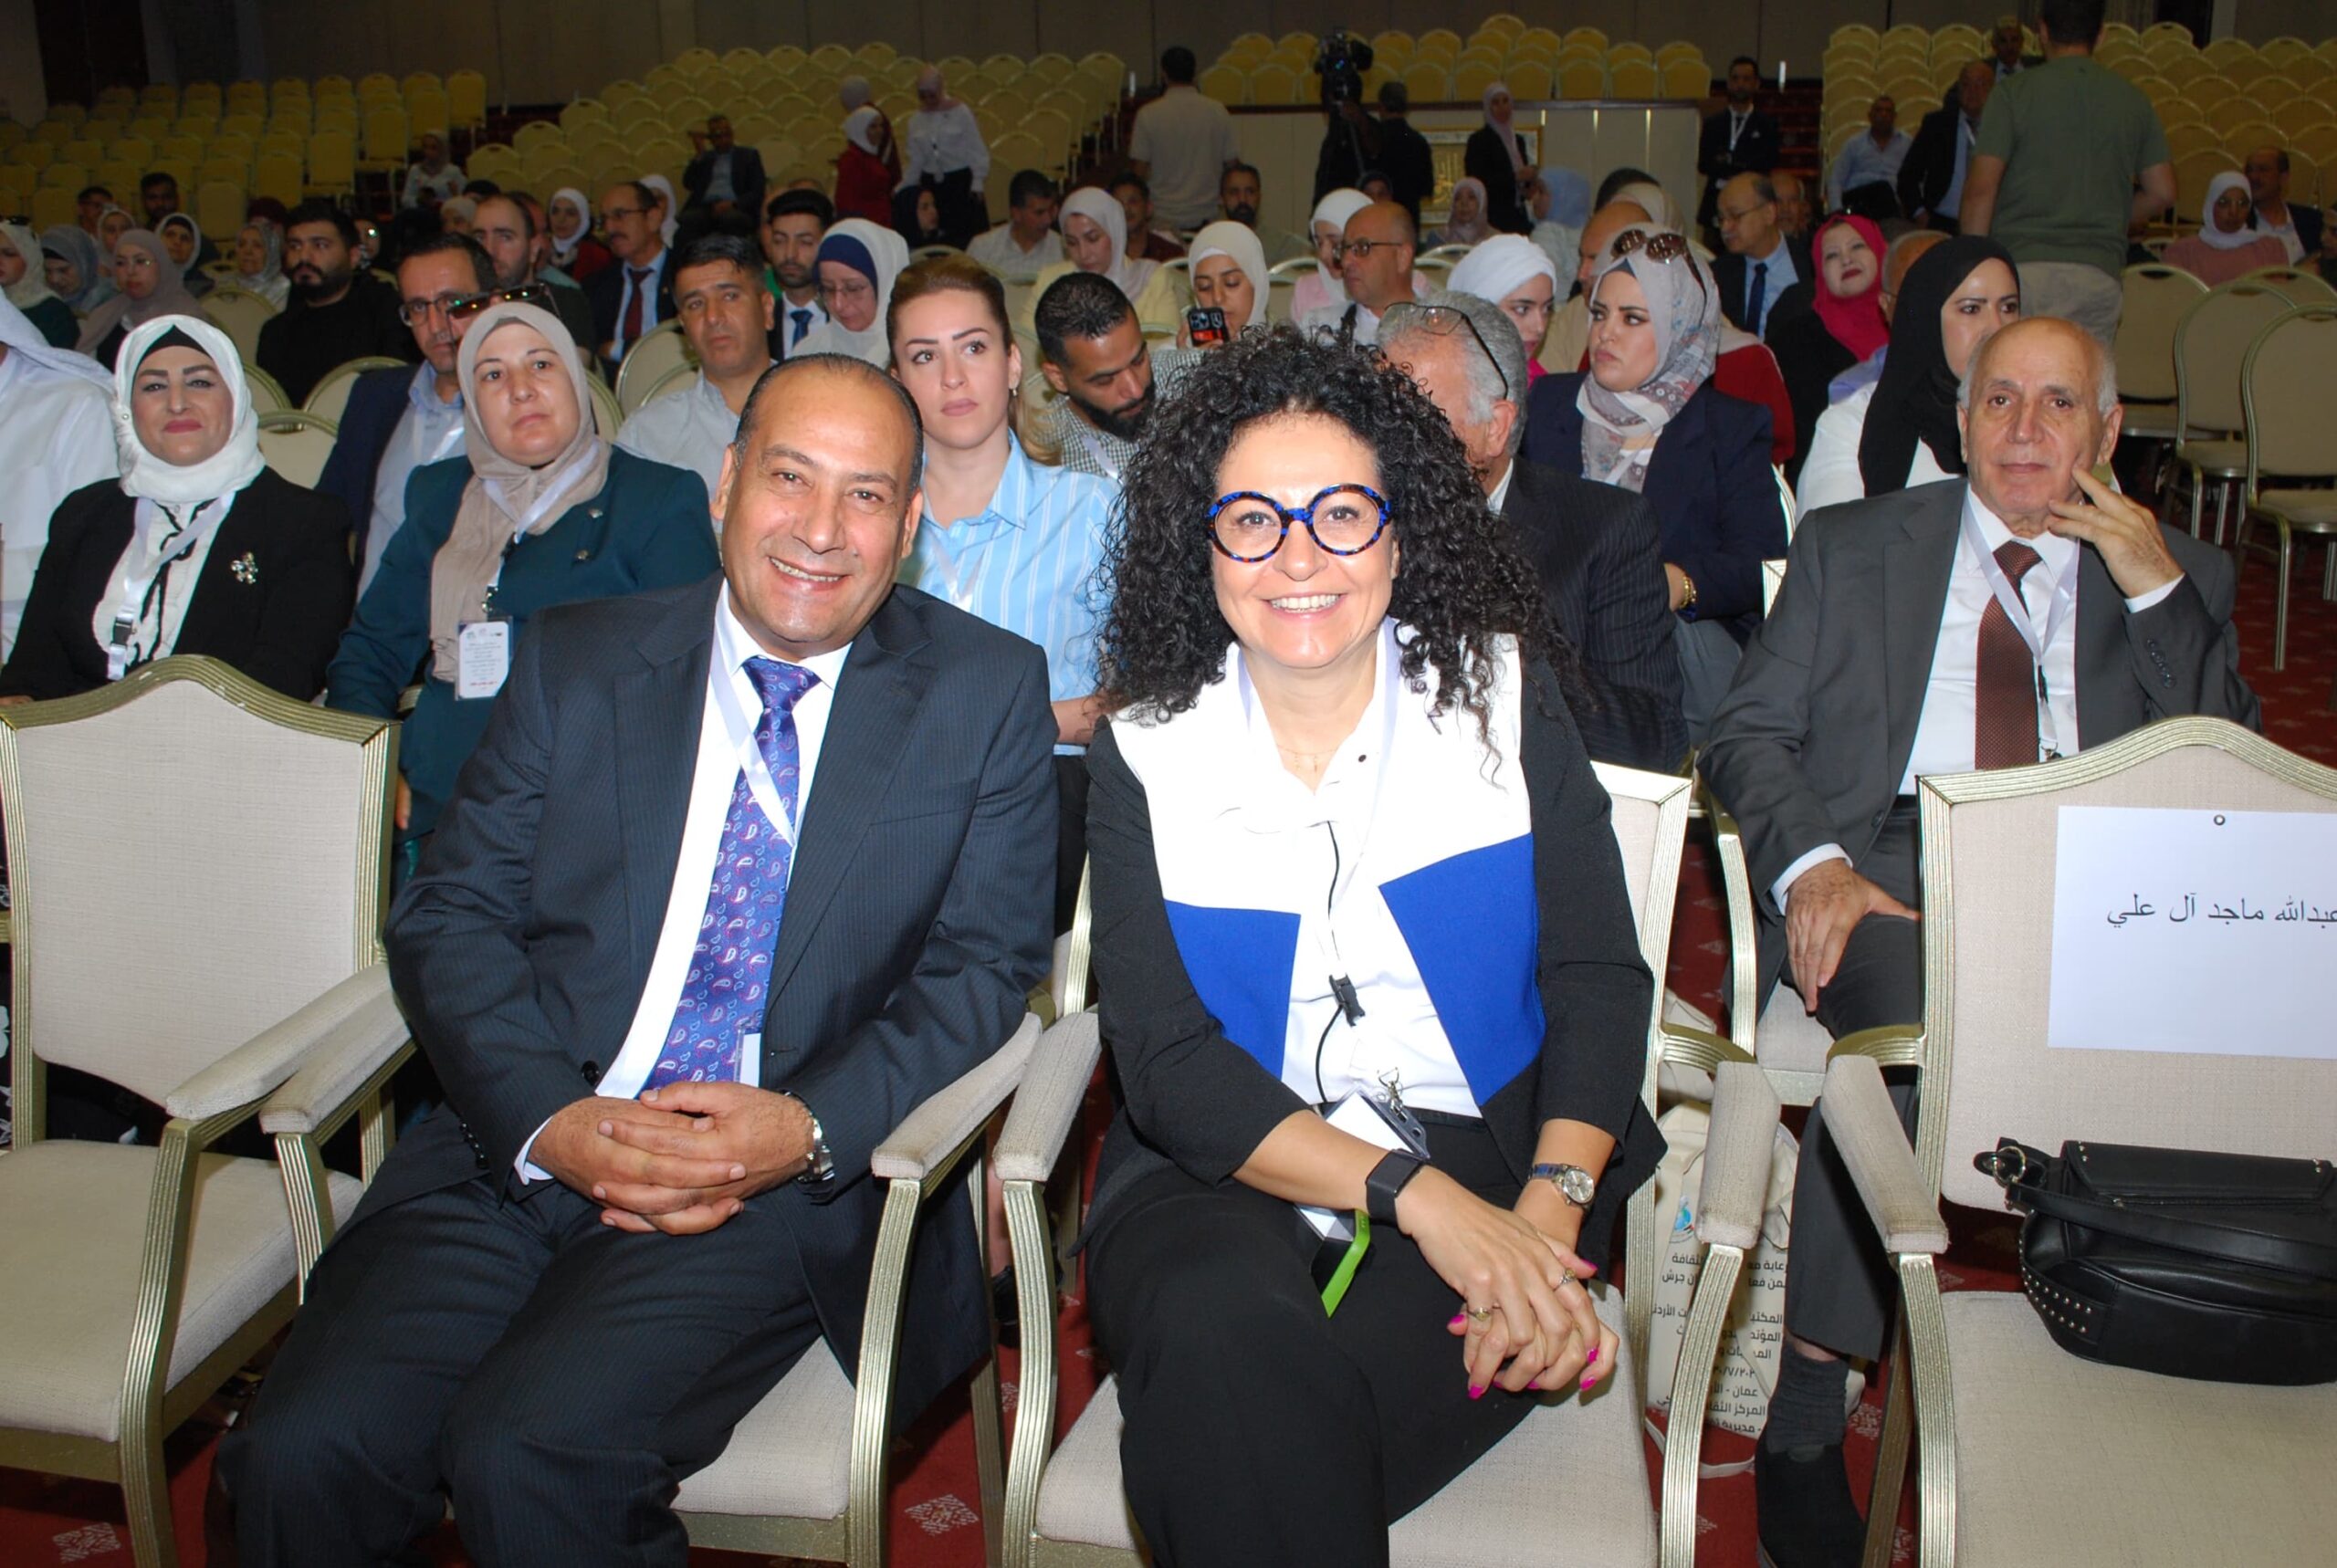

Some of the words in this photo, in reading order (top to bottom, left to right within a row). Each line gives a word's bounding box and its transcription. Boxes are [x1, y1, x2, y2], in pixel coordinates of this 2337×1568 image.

[2106, 893, 2156, 928] علي
[2168, 892, 2196, 923] آل
[2207, 897, 2265, 925] ماجد
[1732, 1385, 1758, 1398] عمان
[1734, 1402, 1766, 1416] المركز
